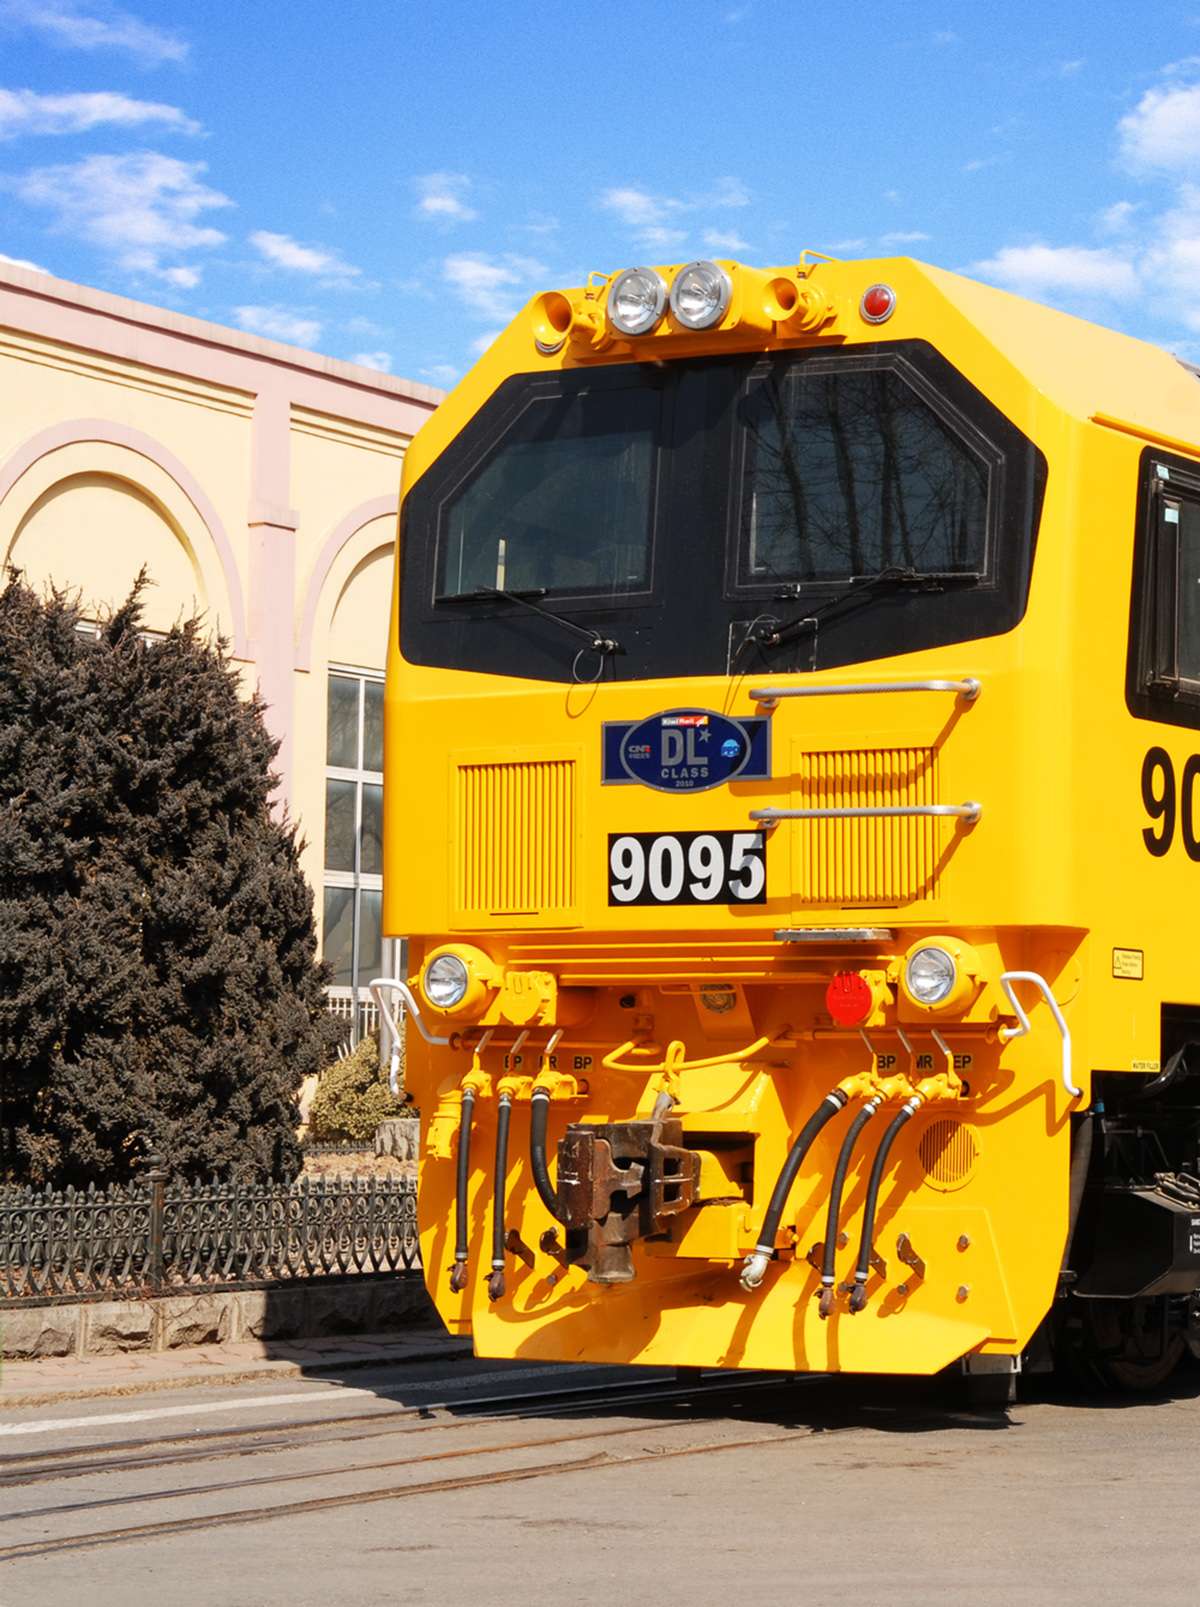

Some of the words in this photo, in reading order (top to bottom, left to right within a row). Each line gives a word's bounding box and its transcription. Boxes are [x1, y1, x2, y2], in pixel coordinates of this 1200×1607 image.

[661, 728, 709, 766] DL
[661, 767, 709, 779] CLASS
[610, 834, 765, 902] 9095
[574, 1056, 592, 1069] BP
[877, 1056, 896, 1069] BP
[953, 1056, 972, 1069] EP
